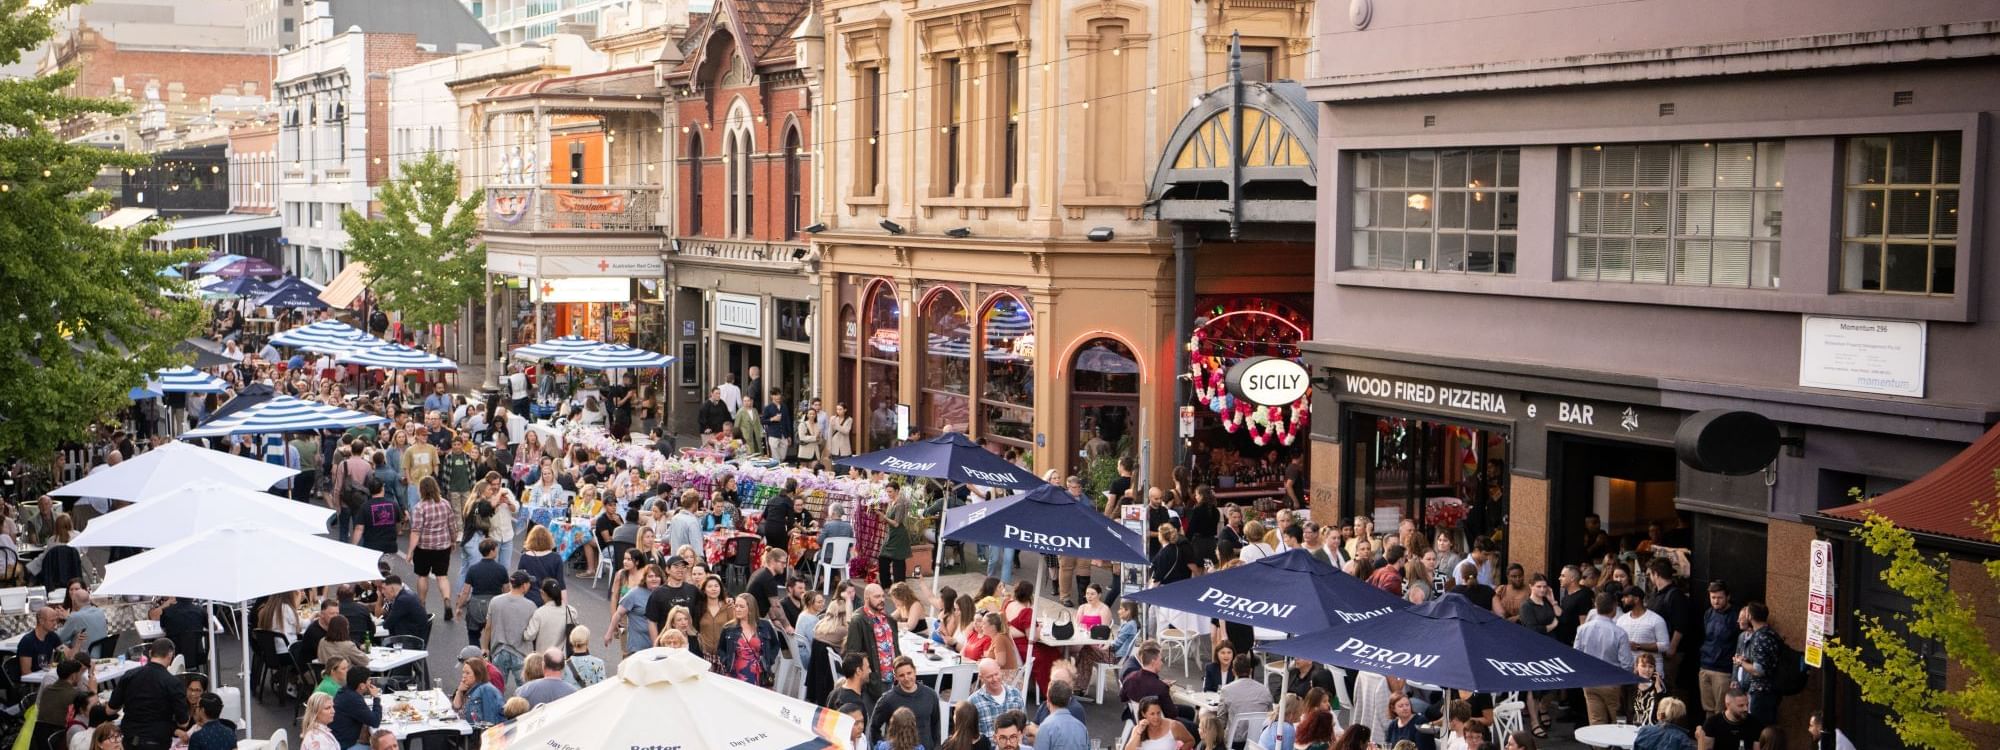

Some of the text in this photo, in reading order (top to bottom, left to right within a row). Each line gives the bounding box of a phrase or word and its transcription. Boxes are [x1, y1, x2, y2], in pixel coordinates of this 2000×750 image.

[846, 321, 856, 336] 290
[1840, 323, 1888, 333] Momentum 296
[1249, 374, 1301, 390] SICILY
[1857, 376, 1910, 390] momentum
[1346, 375, 1594, 425] WOOD FIRED PIZZERIA e BAR
[880, 455, 936, 471] PERONI
[961, 465, 1019, 483] PERONI
[1003, 524, 1091, 549] PERONI
[1028, 544, 1064, 552] ITALIA
[1197, 587, 1297, 618] PERONI
[1216, 608, 1254, 619] ITALIA
[1334, 637, 1441, 668] PERONI
[1353, 659, 1392, 669] ITALIA
[1486, 657, 1576, 676] PERONI
[730, 739, 745, 748] Day
